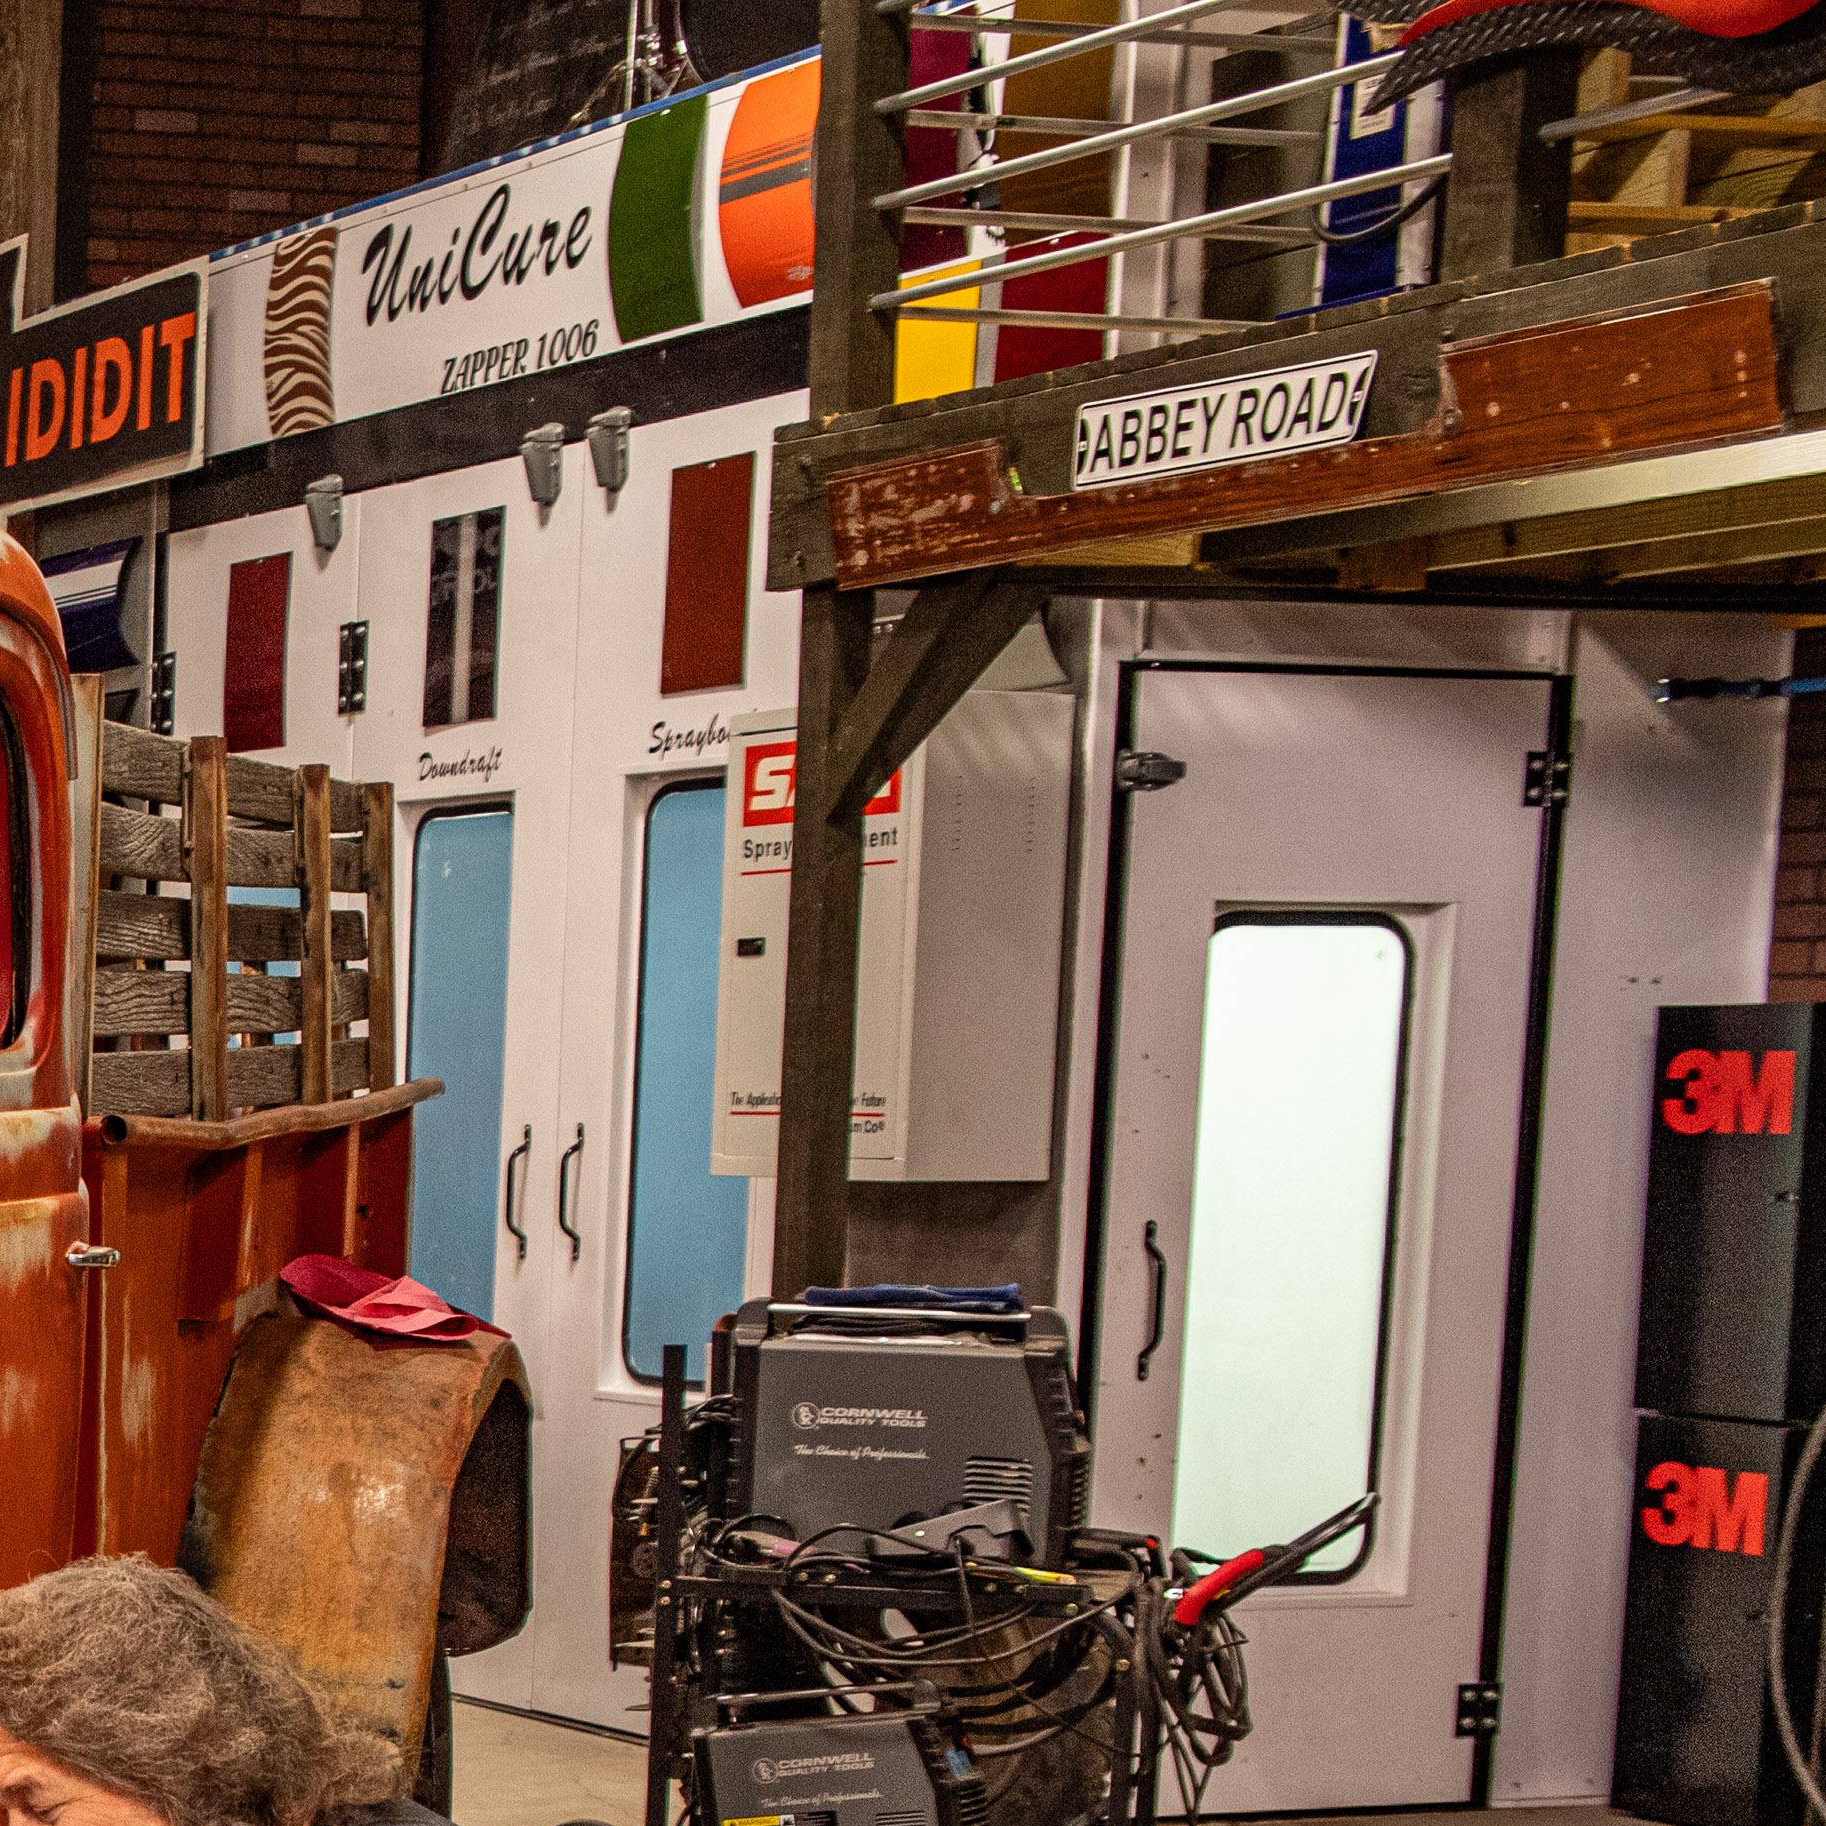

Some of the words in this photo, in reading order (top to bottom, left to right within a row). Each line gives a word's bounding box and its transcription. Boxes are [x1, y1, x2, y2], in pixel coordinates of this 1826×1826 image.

[362, 183, 593, 327] UniCure
[441, 338, 529, 395] ZAPPER
[536, 319, 599, 370] 1006
[5, 312, 197, 467] IDIDIT
[1090, 392, 1228, 473] ABBEY
[1230, 371, 1350, 449] ROAD
[418, 746, 502, 783] Downdraft
[744, 838, 792, 863] Spray
[1662, 1048, 1796, 1135] 3M
[819, 1417, 876, 1426] QUALITY
[881, 1418, 927, 1428] TOOLS
[820, 1406, 928, 1420] CORNWELL
[794, 1444, 814, 1456] The
[1641, 1460, 1769, 1555] 3M
[776, 1765, 828, 1777] QUALITY
[777, 1752, 876, 1769] CORNWELL
